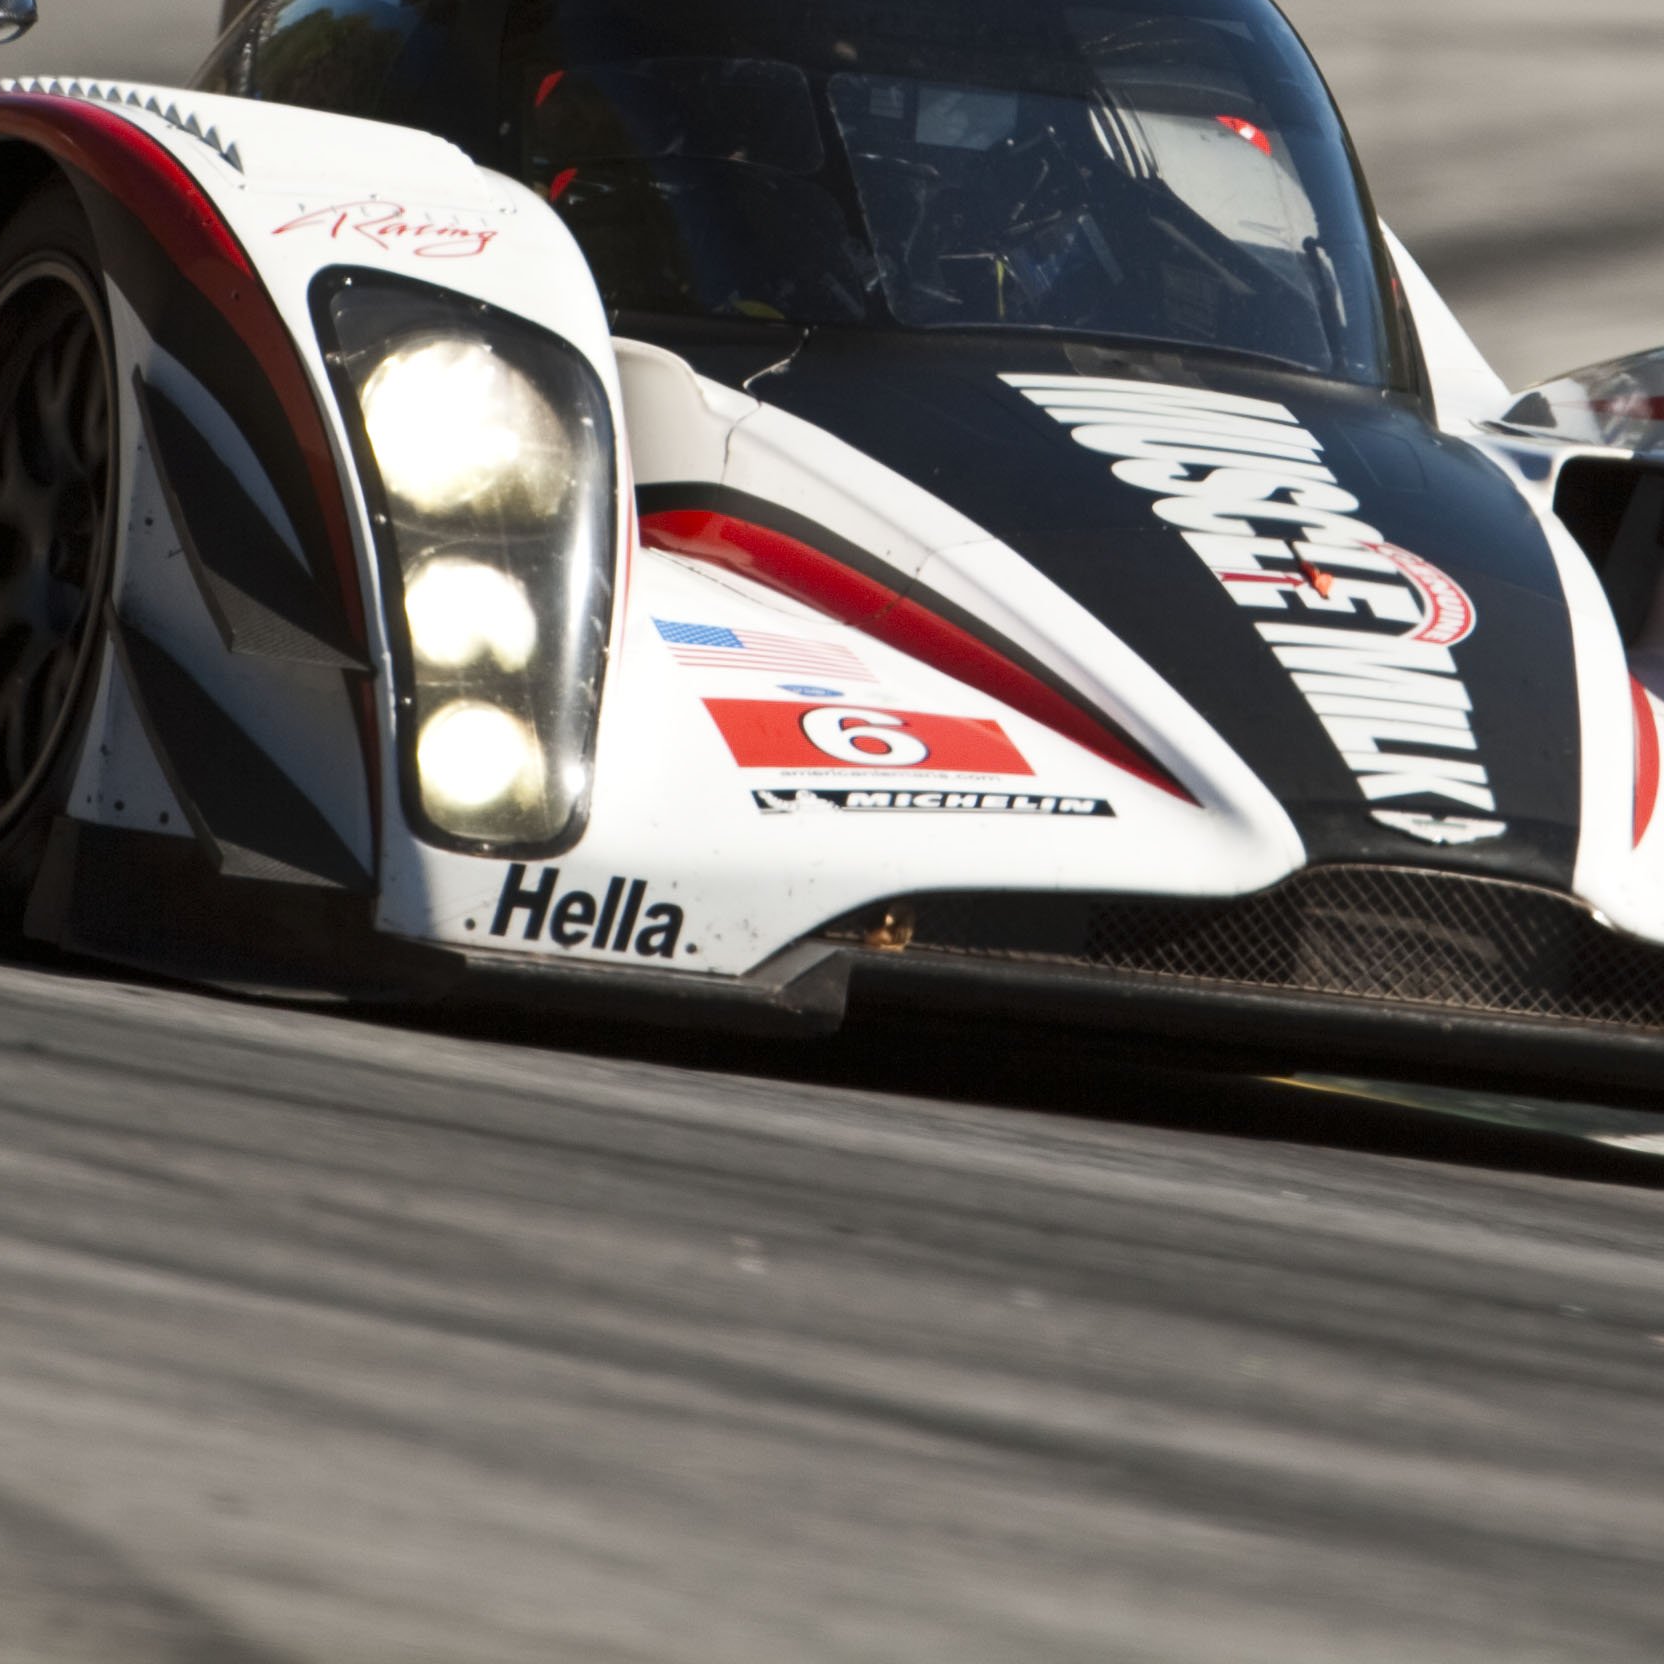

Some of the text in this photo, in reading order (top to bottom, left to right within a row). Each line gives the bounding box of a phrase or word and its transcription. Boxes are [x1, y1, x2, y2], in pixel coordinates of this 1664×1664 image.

[271, 200, 498, 257] Racing
[997, 373, 1497, 811] MUSCLE MILK
[799, 706, 930, 766] 6
[846, 791, 1097, 813] MICHELIN
[489, 863, 685, 959] Hella
